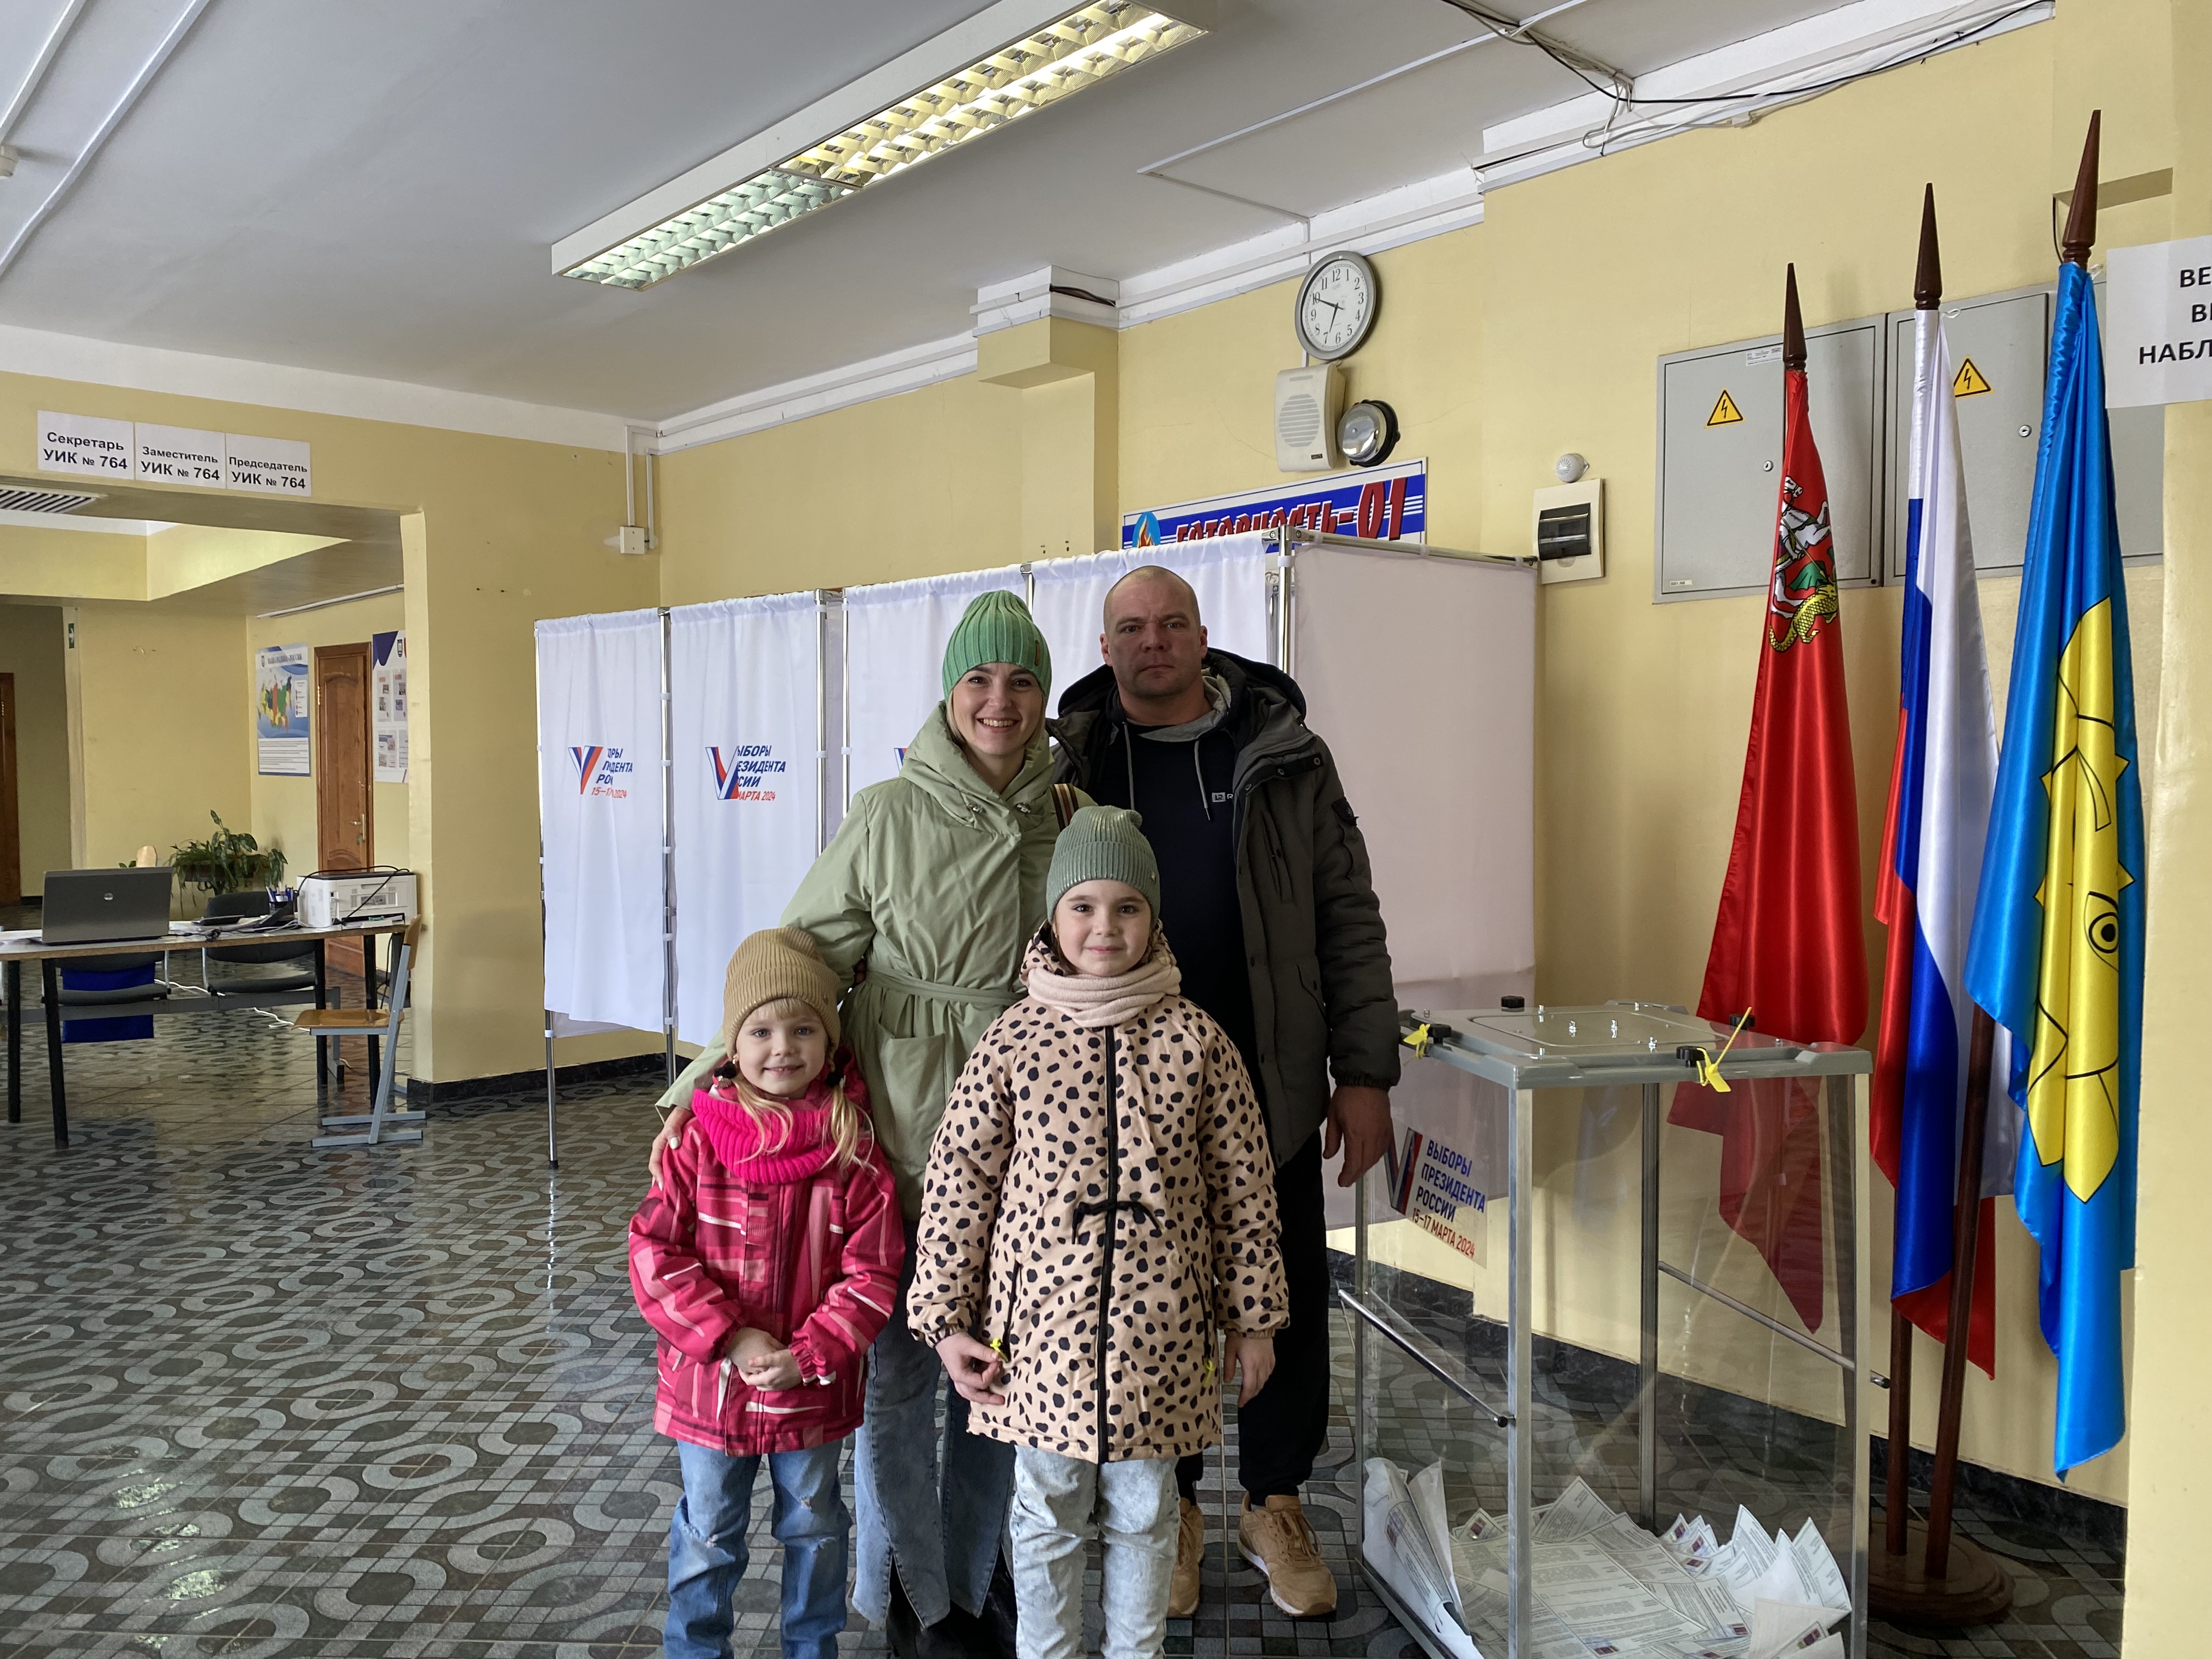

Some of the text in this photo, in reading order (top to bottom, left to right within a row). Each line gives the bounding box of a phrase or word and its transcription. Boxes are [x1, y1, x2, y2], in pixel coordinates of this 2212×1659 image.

[1331, 268, 1341, 282] 12
[1346, 268, 1349, 281] 1
[1321, 277, 1328, 290] 11
[1355, 277, 1360, 290] 2
[1312, 292, 1321, 305] 10
[1358, 292, 1364, 304] 3
[1311, 309, 1316, 321] 9
[1355, 309, 1361, 321] 4
[2192, 303, 2212, 323] В
[1315, 324, 1320, 336] 8
[1347, 324, 1352, 336] 5
[1323, 332, 1328, 344] 7
[1335, 332, 1341, 344] 6
[47, 432, 124, 451] Секретарь
[43, 448, 127, 469] УИК № 764
[143, 446, 218, 463] Заместитель
[140, 461, 219, 480] УИК № 764
[229, 456, 307, 472] Председатель
[231, 471, 262, 484] УИК
[281, 476, 306, 489] 764
[608, 748, 623, 758] ОРЫ
[761, 791, 776, 801] 2024
[1426, 1139, 1473, 1177] ВЫБОРЫ
[1421, 1163, 1486, 1214] ПРЕЗИДЕНТА
[1416, 1186, 1457, 1223] РОССИИ
[1431, 1219, 1456, 1248] МАРТА
[1457, 1235, 1476, 1259] 2024
